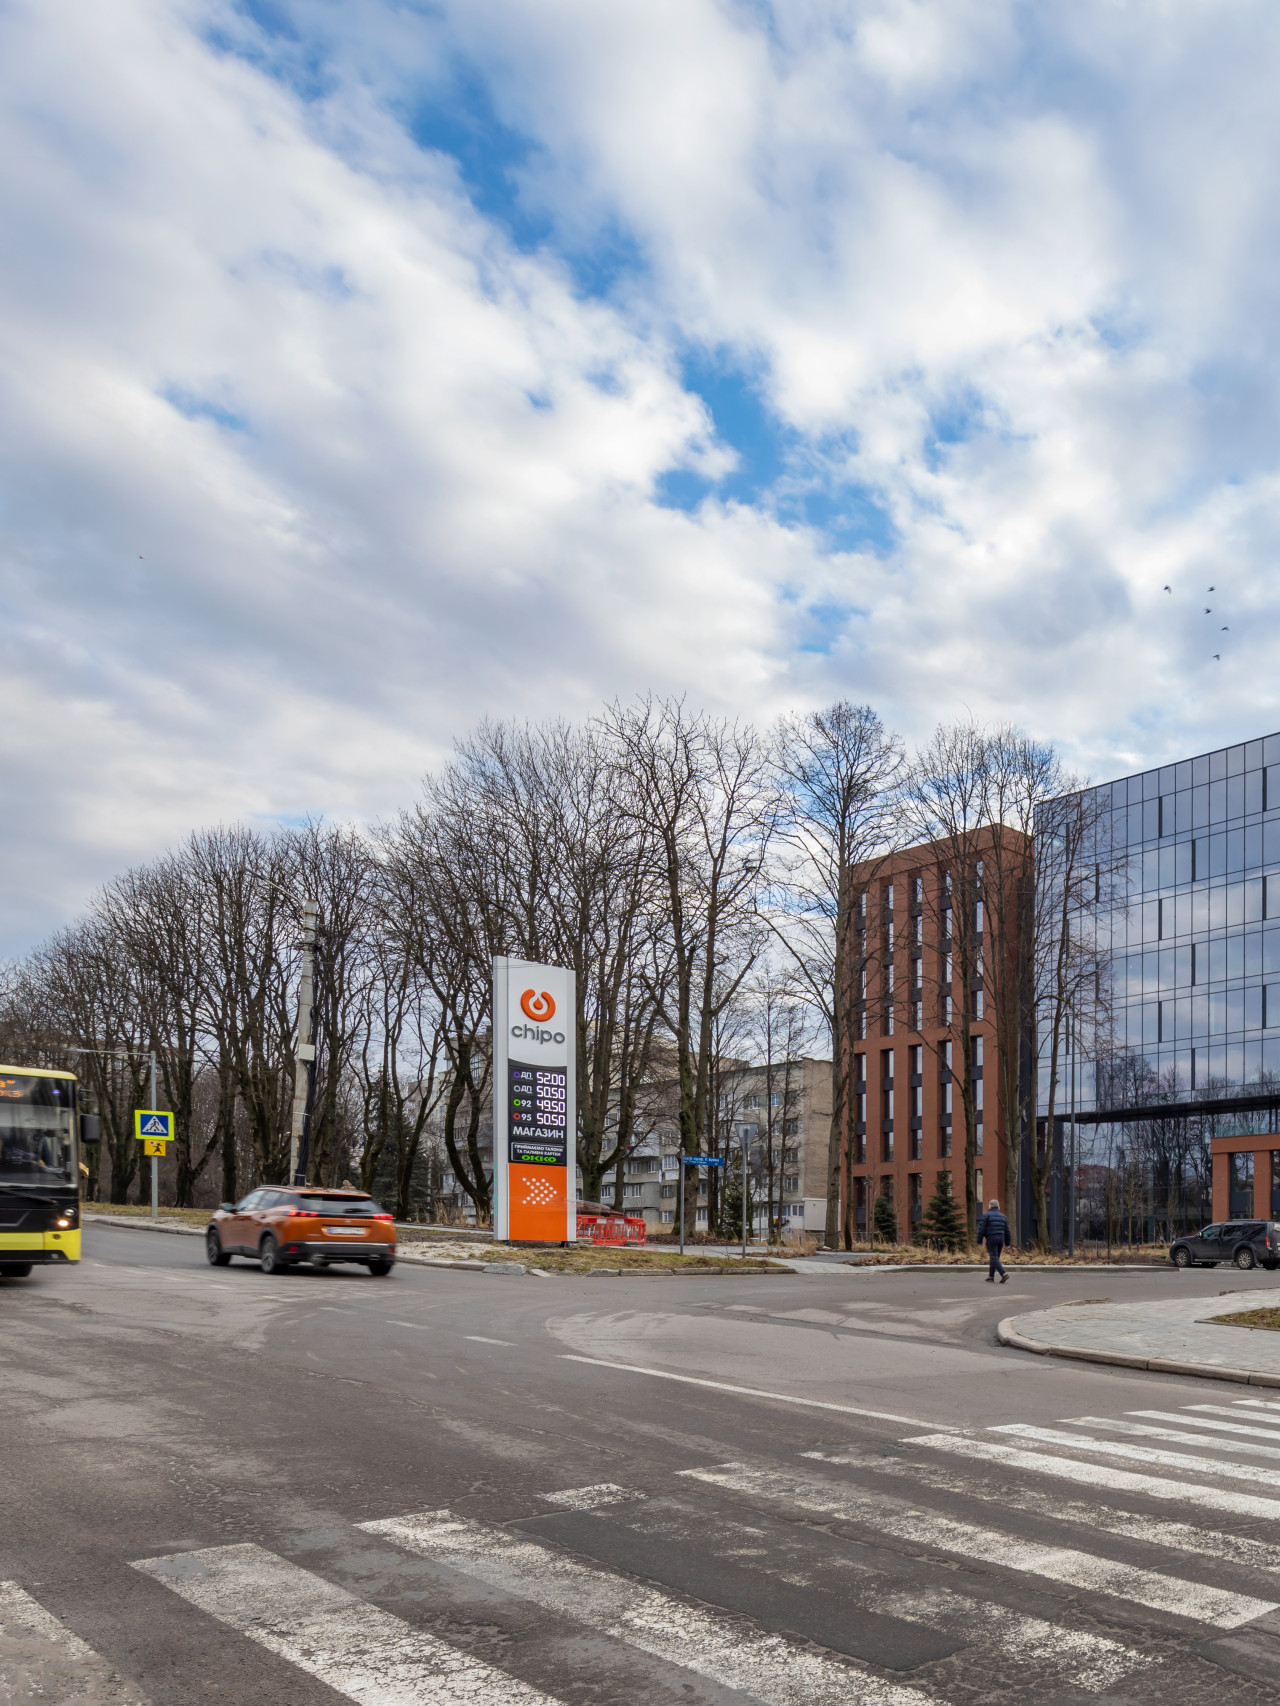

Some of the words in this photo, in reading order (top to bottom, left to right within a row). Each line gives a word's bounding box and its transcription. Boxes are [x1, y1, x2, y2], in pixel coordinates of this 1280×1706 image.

[511, 1023, 566, 1045] chipo
[536, 1072, 565, 1086] 52.00
[536, 1085, 565, 1100] 50.50
[521, 1099, 532, 1108] 92
[536, 1099, 565, 1113] 49.50
[521, 1113, 532, 1121] 95
[536, 1112, 565, 1127] 50.50
[513, 1125, 564, 1139] МАГАЗИН
